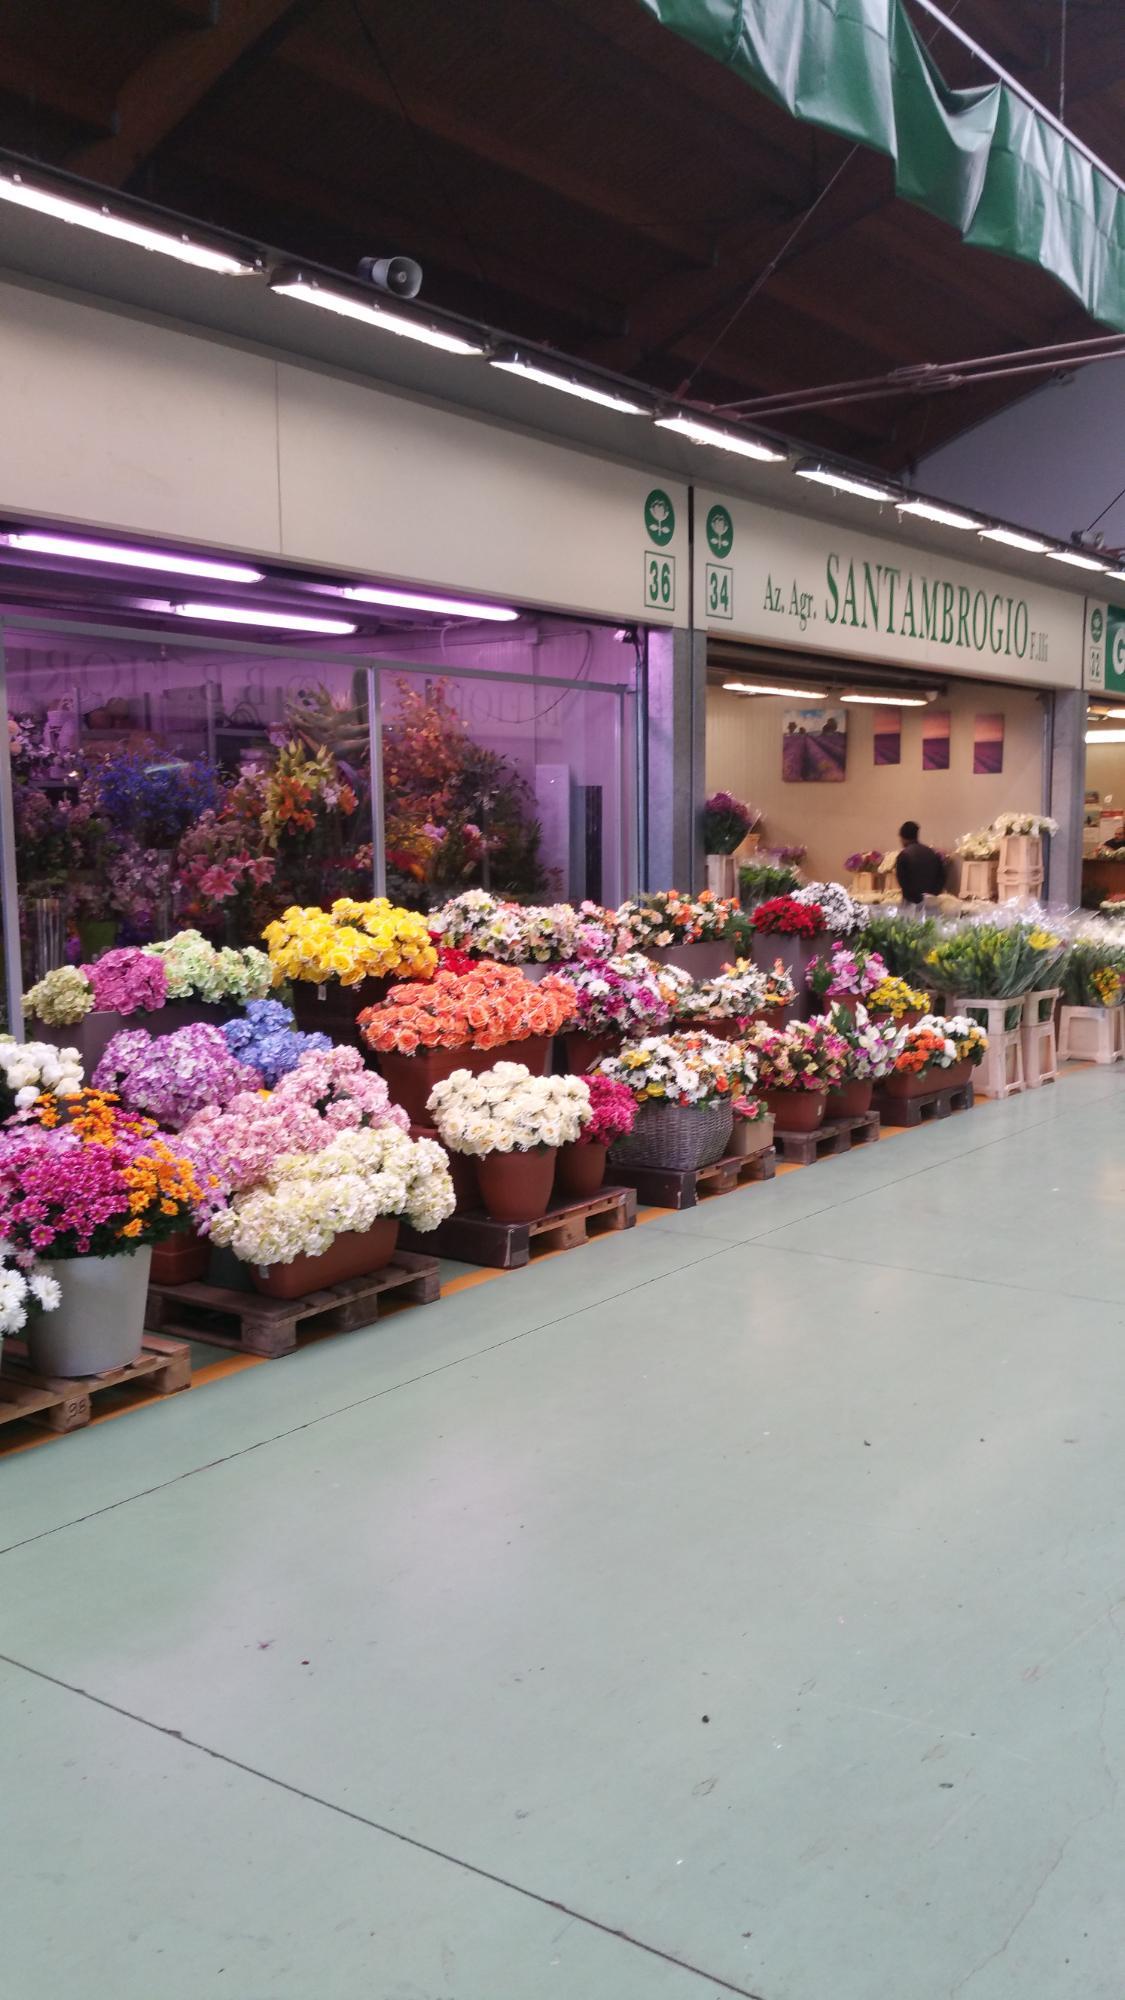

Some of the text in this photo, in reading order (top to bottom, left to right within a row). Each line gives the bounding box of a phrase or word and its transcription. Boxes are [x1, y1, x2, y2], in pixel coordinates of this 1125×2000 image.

[649, 559, 672, 604] 36
[709, 571, 730, 613] 34
[763, 572, 785, 614] Az.
[788, 577, 818, 632] Agr.
[825, 551, 1029, 659] SANTAMBROGIO
